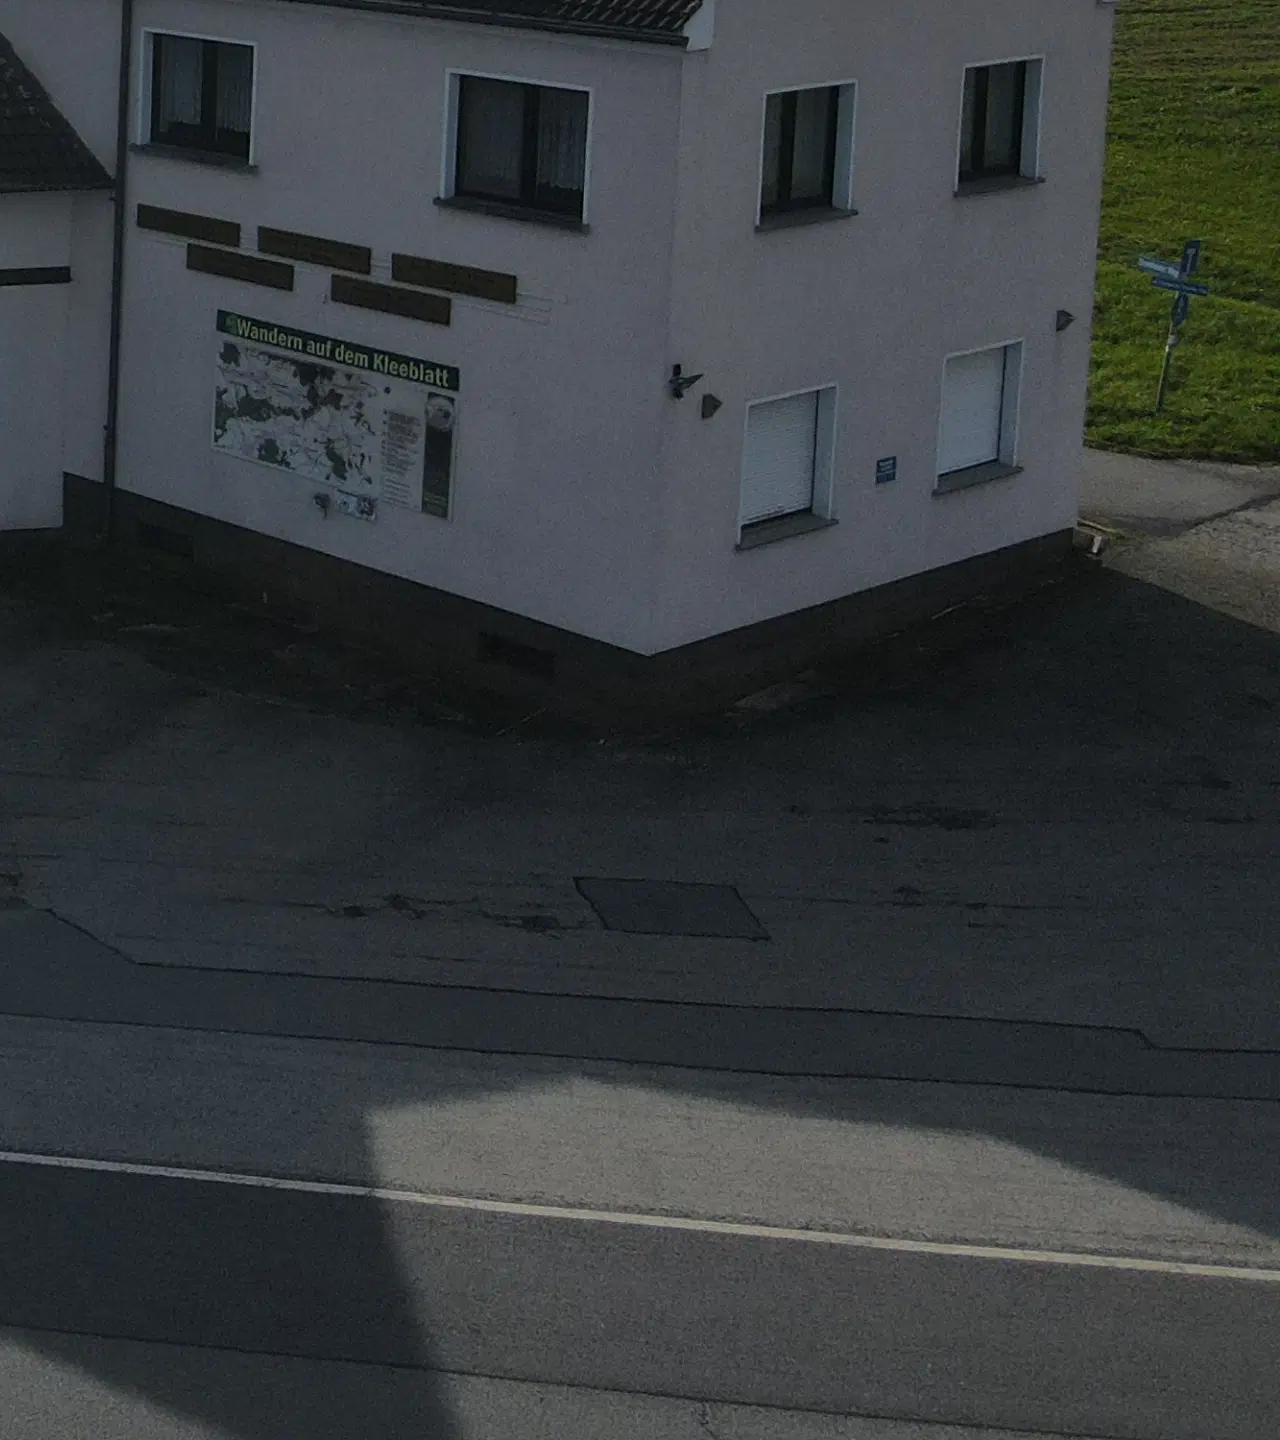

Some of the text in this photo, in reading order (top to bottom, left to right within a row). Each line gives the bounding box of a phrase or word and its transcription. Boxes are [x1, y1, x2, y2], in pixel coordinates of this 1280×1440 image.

[236, 318, 449, 388] Wandern auf dem Kleeblatt
